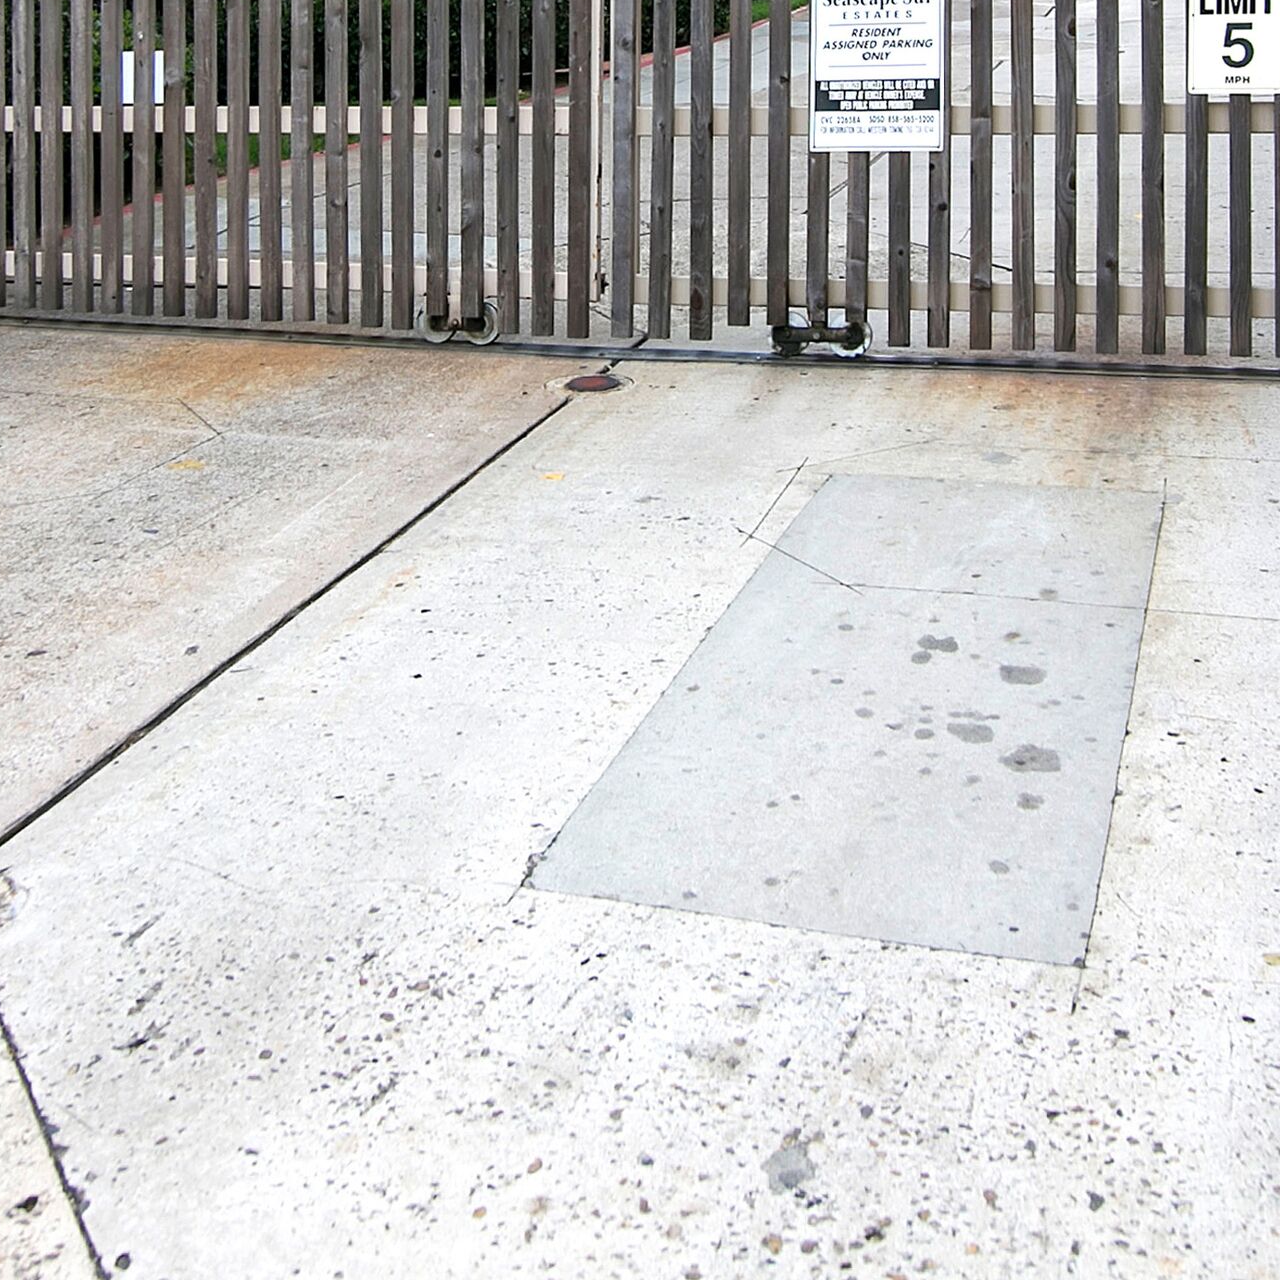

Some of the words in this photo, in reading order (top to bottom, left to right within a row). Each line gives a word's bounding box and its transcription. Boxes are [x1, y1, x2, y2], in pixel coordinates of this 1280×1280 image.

[842, 9, 913, 20] ESTATES
[851, 27, 902, 38] RESIDENT
[823, 40, 878, 50] ASSIGNED
[882, 38, 933, 49] PARKING
[1221, 22, 1255, 69] 5
[862, 51, 891, 61] ONLY
[1224, 75, 1251, 85] MPH
